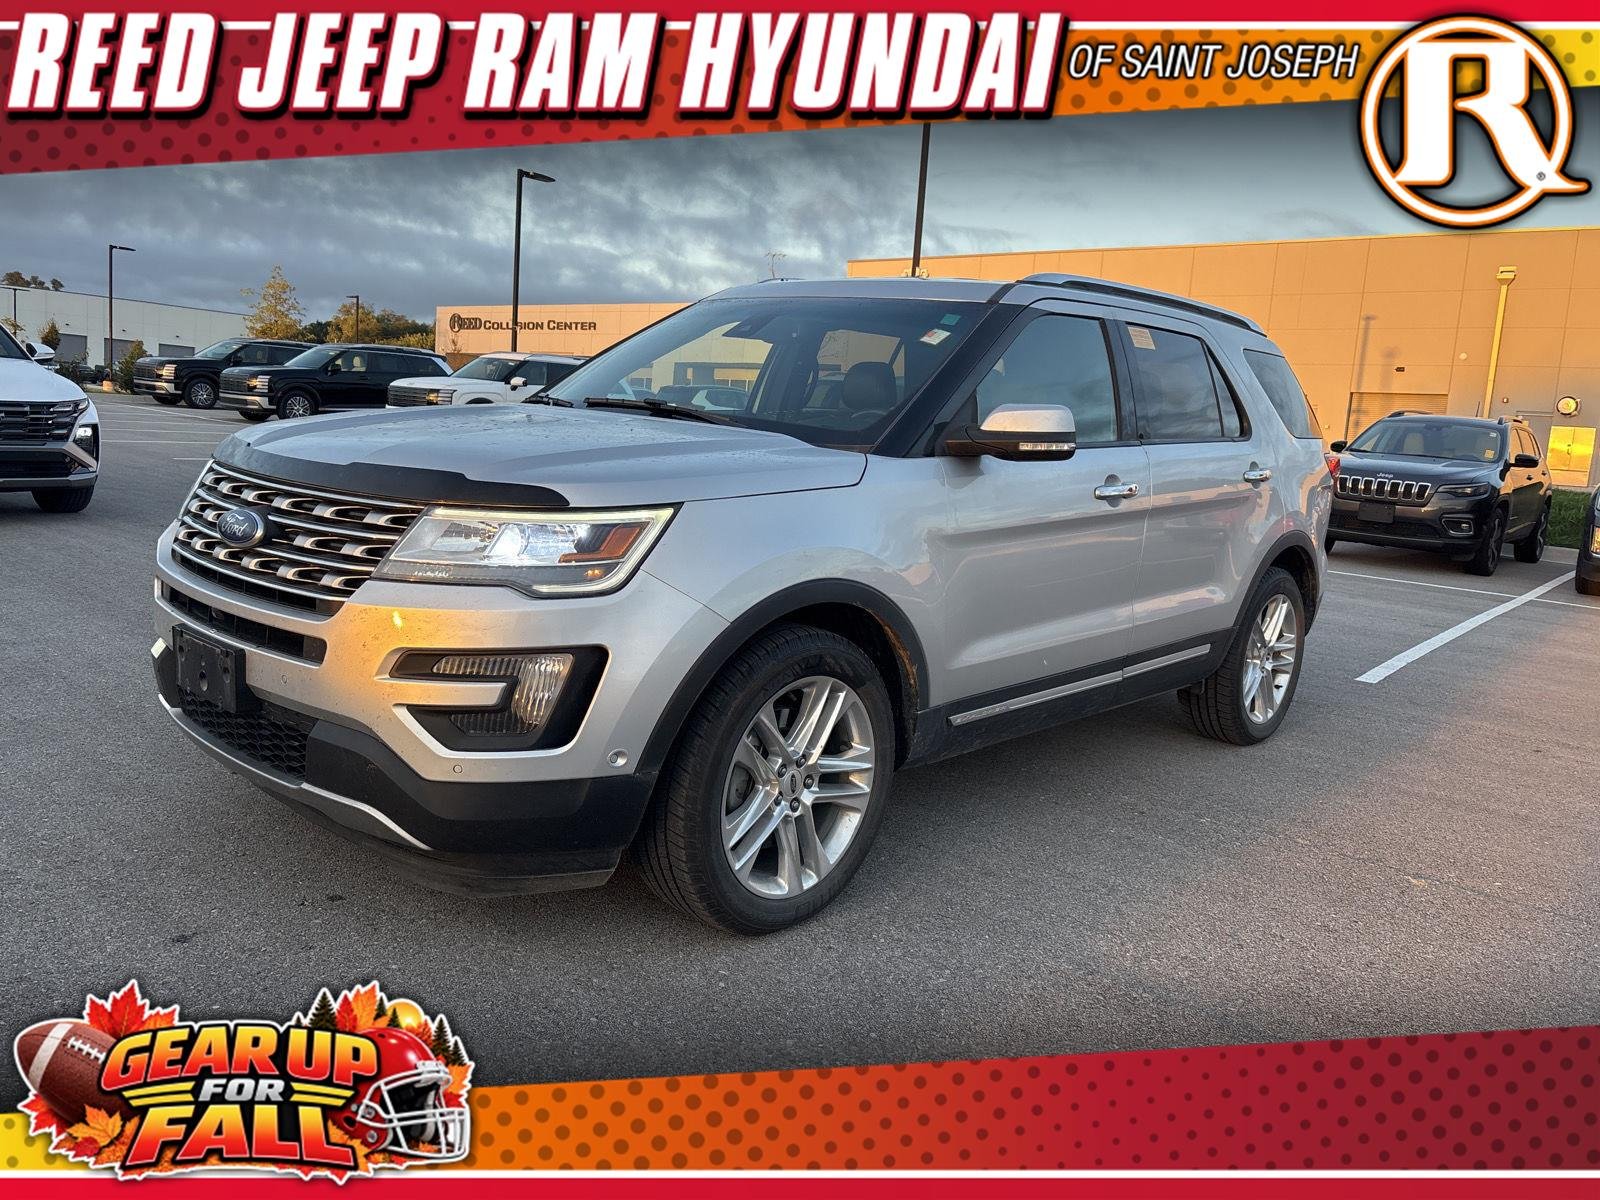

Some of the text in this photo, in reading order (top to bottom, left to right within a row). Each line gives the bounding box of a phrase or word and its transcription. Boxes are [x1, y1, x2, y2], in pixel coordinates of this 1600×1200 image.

[483, 320, 544, 331] COLLSION
[547, 320, 597, 331] CENTER
[221, 513, 248, 536] Ford
